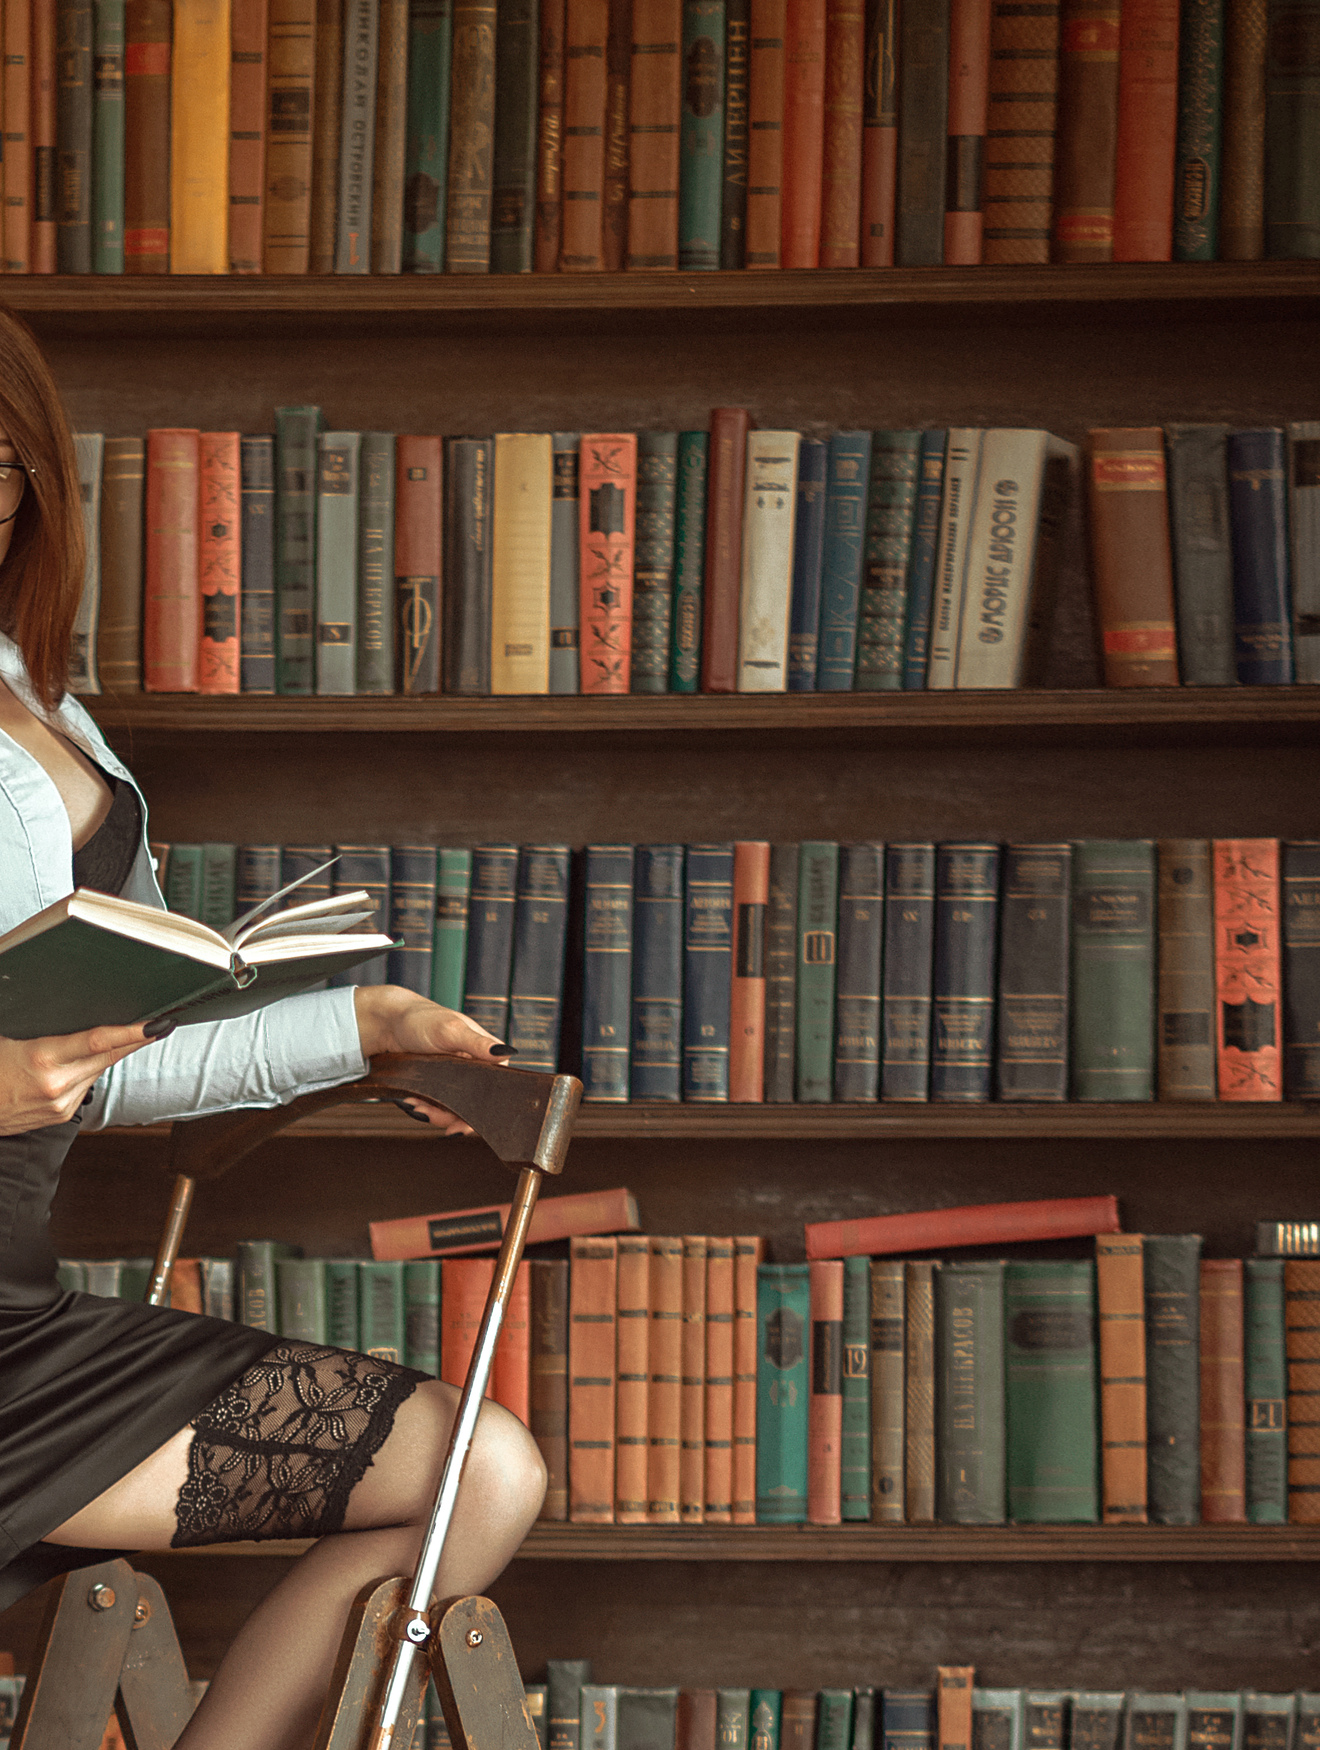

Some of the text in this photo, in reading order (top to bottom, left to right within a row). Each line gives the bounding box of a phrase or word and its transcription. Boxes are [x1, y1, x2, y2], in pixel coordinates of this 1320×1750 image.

[726, 18, 747, 140] ГЕРЦЕН
[348, 119, 366, 227] ОСТРОВСКИЙ
[981, 500, 1018, 627] МОРИС ДРЮОН
[846, 1347, 867, 1374] 19
[953, 1307, 977, 1397] НЕКРАСОВ
